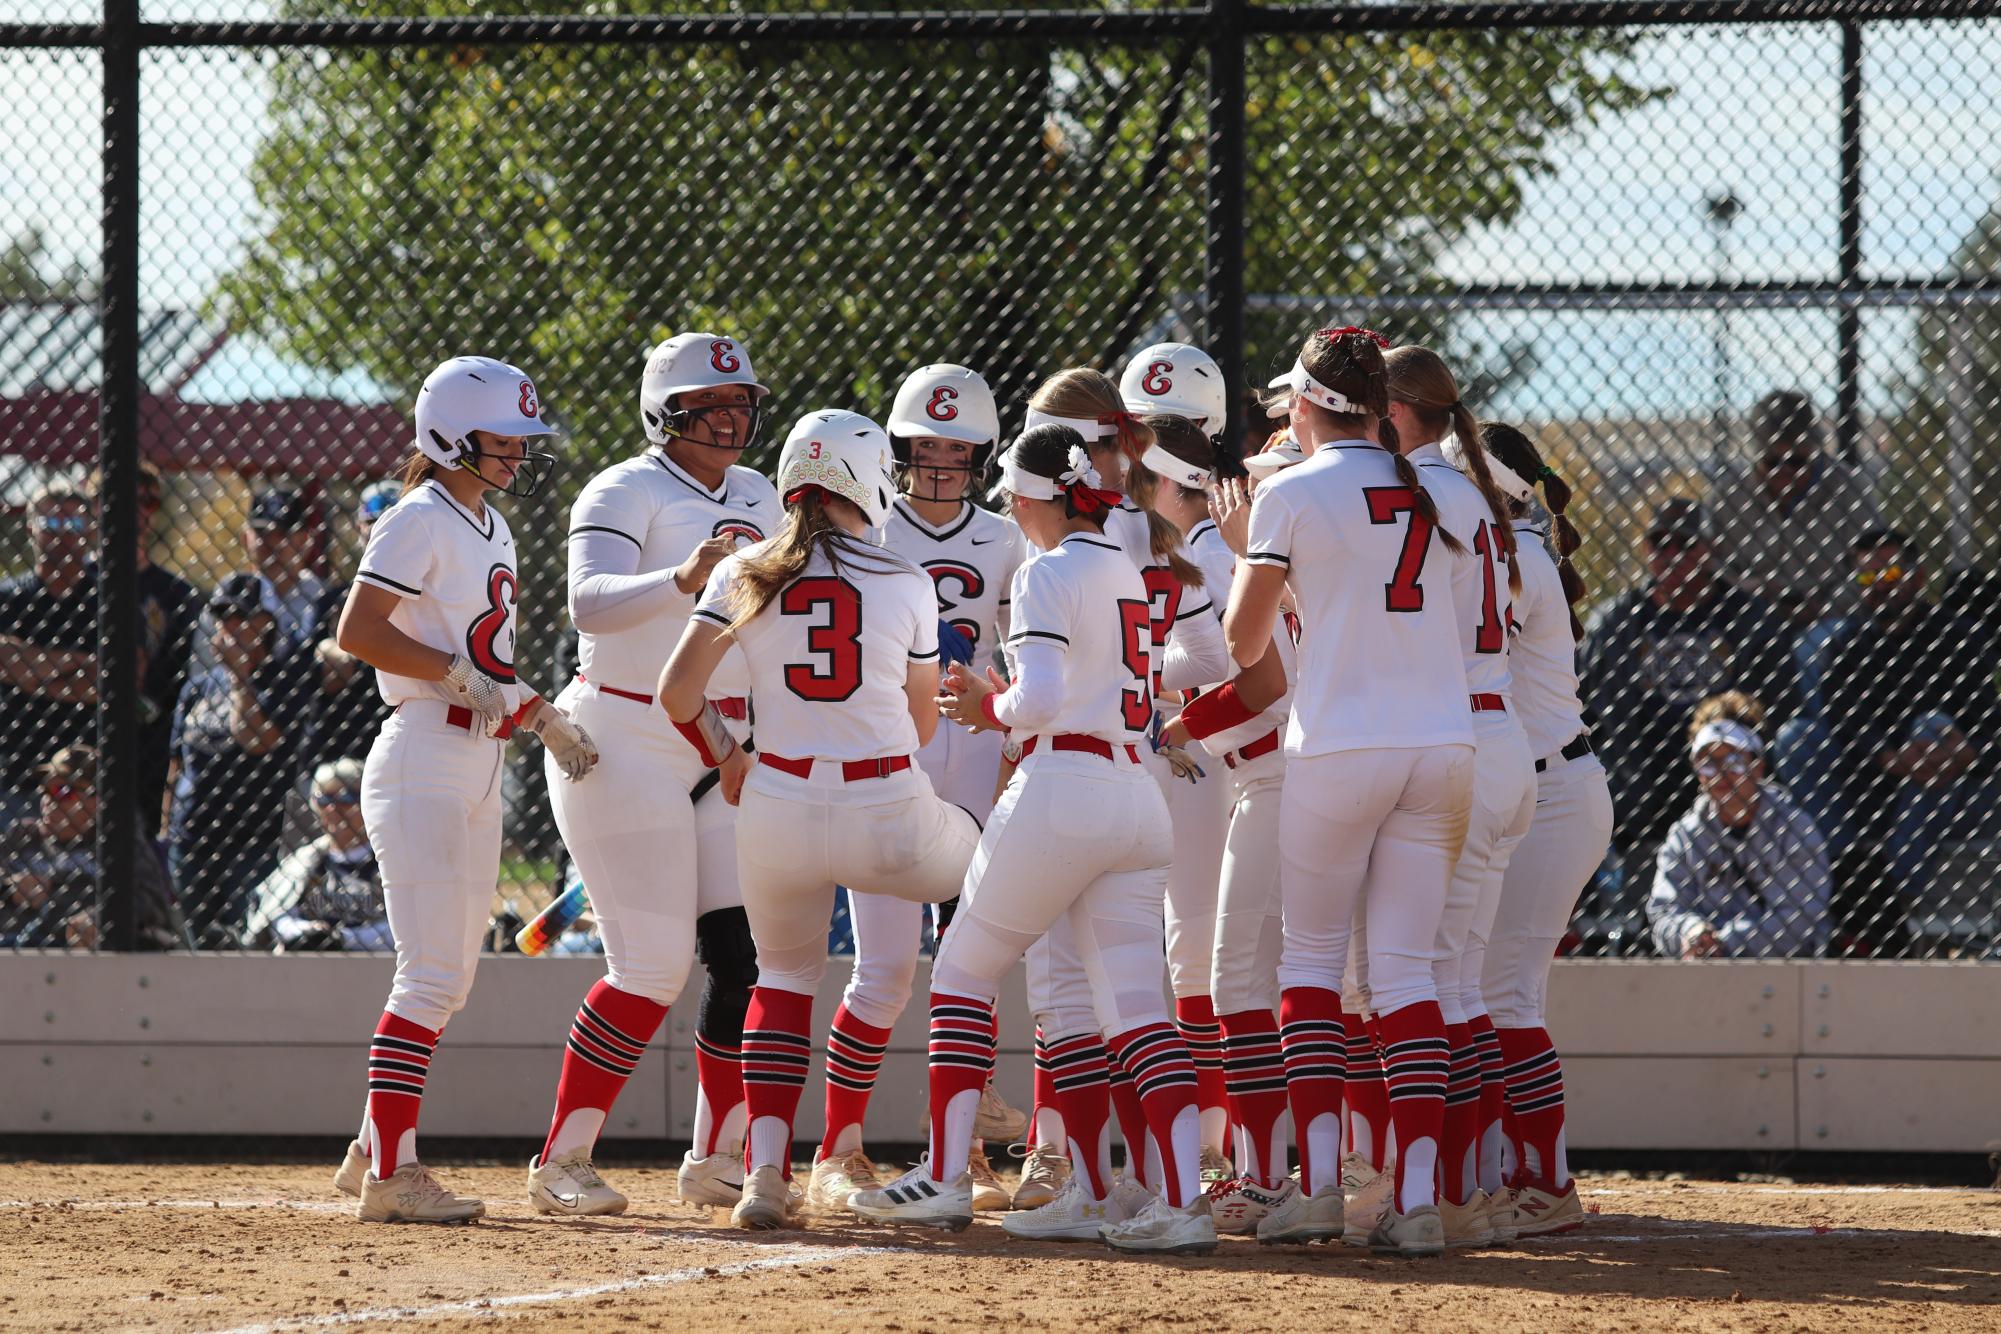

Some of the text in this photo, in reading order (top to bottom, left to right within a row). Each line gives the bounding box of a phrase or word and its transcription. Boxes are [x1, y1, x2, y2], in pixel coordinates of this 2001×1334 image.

[711, 340, 740, 373] E
[1142, 360, 1173, 395] E
[519, 380, 537, 418] E
[926, 386, 958, 421] E
[809, 441, 821, 459] 3
[1362, 486, 1434, 612] 7
[1473, 519, 1513, 656] 1
[466, 562, 518, 684] E
[781, 576, 862, 702] 3
[1117, 599, 1152, 732] 5
